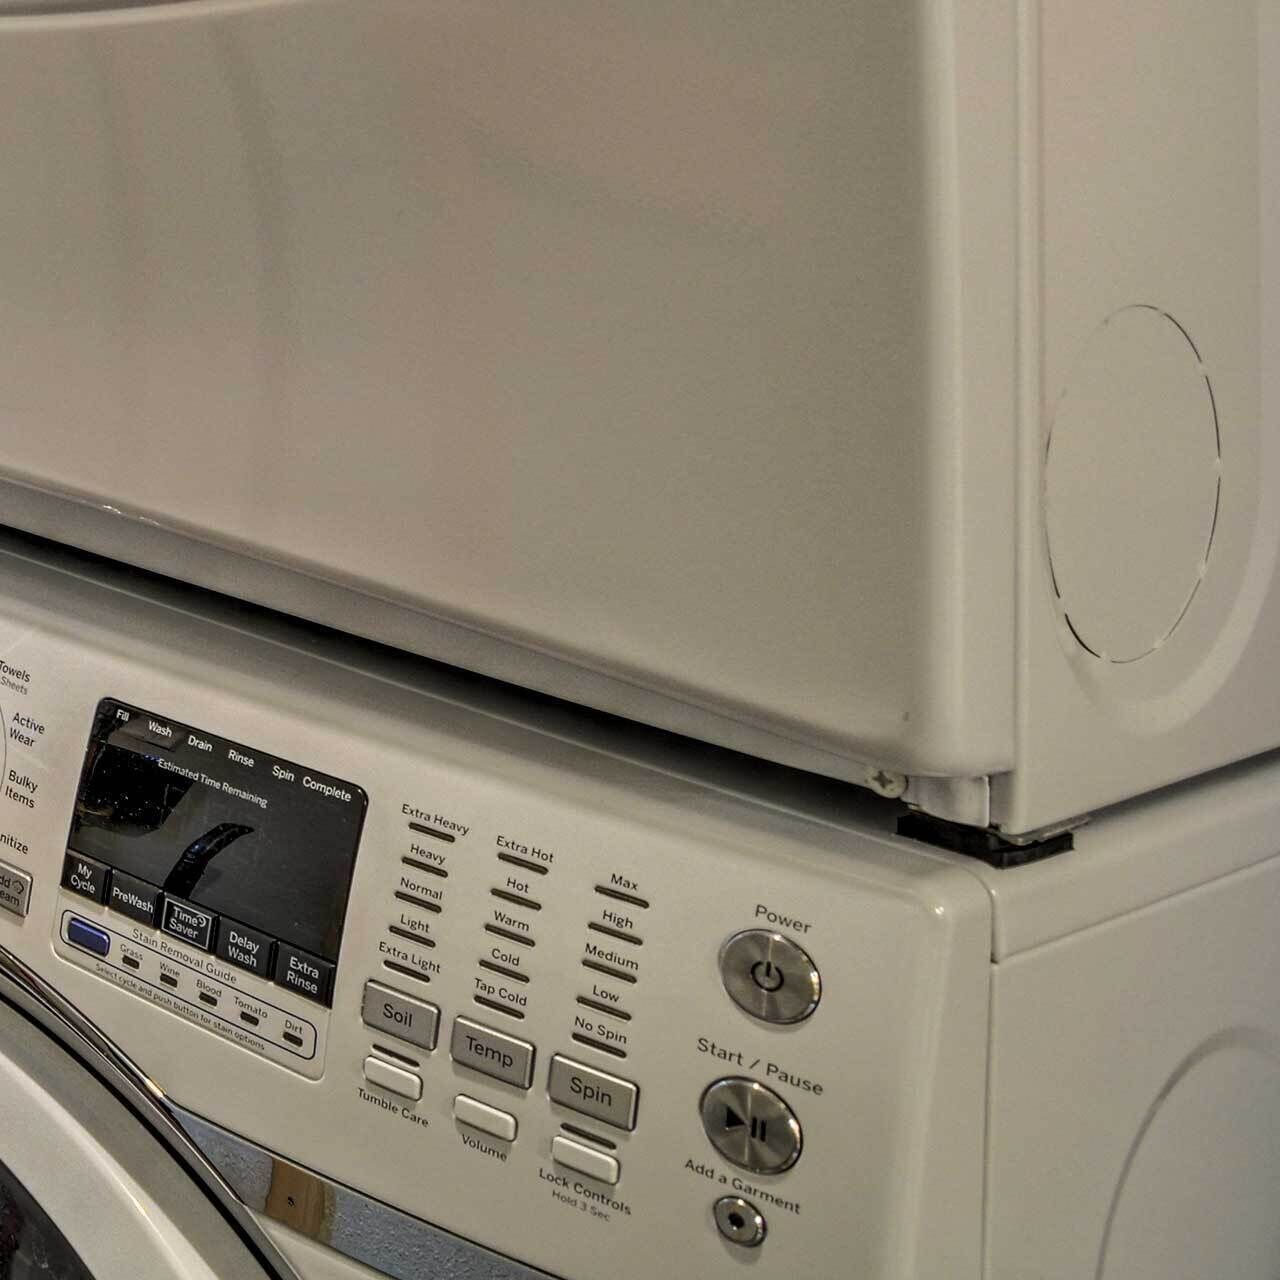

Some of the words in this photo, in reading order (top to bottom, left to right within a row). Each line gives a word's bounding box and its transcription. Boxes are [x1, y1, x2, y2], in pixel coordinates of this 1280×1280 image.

[0, 676, 28, 696] Sheets
[12, 712, 45, 735] Active
[116, 708, 130, 722] Fill
[10, 727, 36, 748] Wear
[148, 720, 173, 738] Wash
[188, 735, 213, 753] Drain
[228, 749, 255, 768] Rinse
[8, 770, 38, 794] Bulky
[158, 758, 200, 782] Estimated
[200, 773, 221, 790] Time
[222, 782, 269, 809] Remaining
[272, 765, 295, 783] Spin
[5, 785, 35, 809] Items
[302, 776, 352, 803] Complete
[401, 802, 431, 822] Extra
[434, 814, 470, 837] Heavy
[410, 842, 446, 866] Heavy
[496, 834, 528, 856] Extra
[531, 846, 555, 864] Hot
[78, 863, 93, 880] My
[610, 872, 639, 892] Max
[70, 875, 96, 894] Cycle
[400, 876, 443, 902] Normal
[506, 876, 530, 894] Hot
[112, 886, 154, 914] PreWash
[169, 918, 199, 939] Saver
[173, 906, 197, 927] Time
[400, 914, 431, 934] Light
[494, 910, 530, 933] Warm
[602, 909, 634, 930] High
[754, 903, 812, 936] Power
[120, 944, 144, 962] Grass
[229, 930, 260, 955] Delay
[132, 928, 158, 949] Stain
[160, 942, 204, 970] Removal
[206, 963, 238, 985] Guide
[228, 945, 257, 968] Wash
[289, 956, 320, 980] Extra
[379, 940, 408, 962] Extra
[411, 953, 441, 975] Light
[491, 948, 521, 968] Cold
[584, 942, 640, 971] Medium
[160, 961, 181, 978] Wine
[196, 978, 223, 998] Blood
[286, 970, 319, 995] Rinse
[474, 977, 496, 996] Tap
[498, 986, 528, 1007] Cold
[592, 984, 620, 1004] Low
[96, 963, 119, 981] Select
[118, 974, 138, 989] cycle
[138, 984, 153, 997] and
[154, 992, 172, 1007] push
[174, 1000, 200, 1020] button
[200, 1014, 213, 1026] for
[214, 1020, 234, 1036] stain
[234, 1028, 265, 1051] options
[234, 996, 269, 1019] Tomato
[382, 1003, 413, 1029] Soil
[284, 1019, 304, 1035] Dirt
[574, 1016, 594, 1032] No
[596, 1024, 628, 1045] Spin
[465, 1034, 514, 1069] Temp
[696, 1036, 744, 1067] Start
[748, 1058, 761, 1070] /
[765, 1062, 824, 1096] Pause
[569, 1076, 613, 1108] Spin
[357, 1087, 399, 1114] Tumble
[401, 1106, 430, 1128] Care
[460, 1133, 508, 1163] Volume
[538, 1168, 570, 1189] Lock
[574, 1182, 632, 1216] Controls
[684, 1158, 716, 1181] Add
[718, 1172, 728, 1186] a
[731, 1176, 802, 1216] Garment
[552, 1190, 578, 1209] Hold
[590, 1206, 611, 1223] Sec
